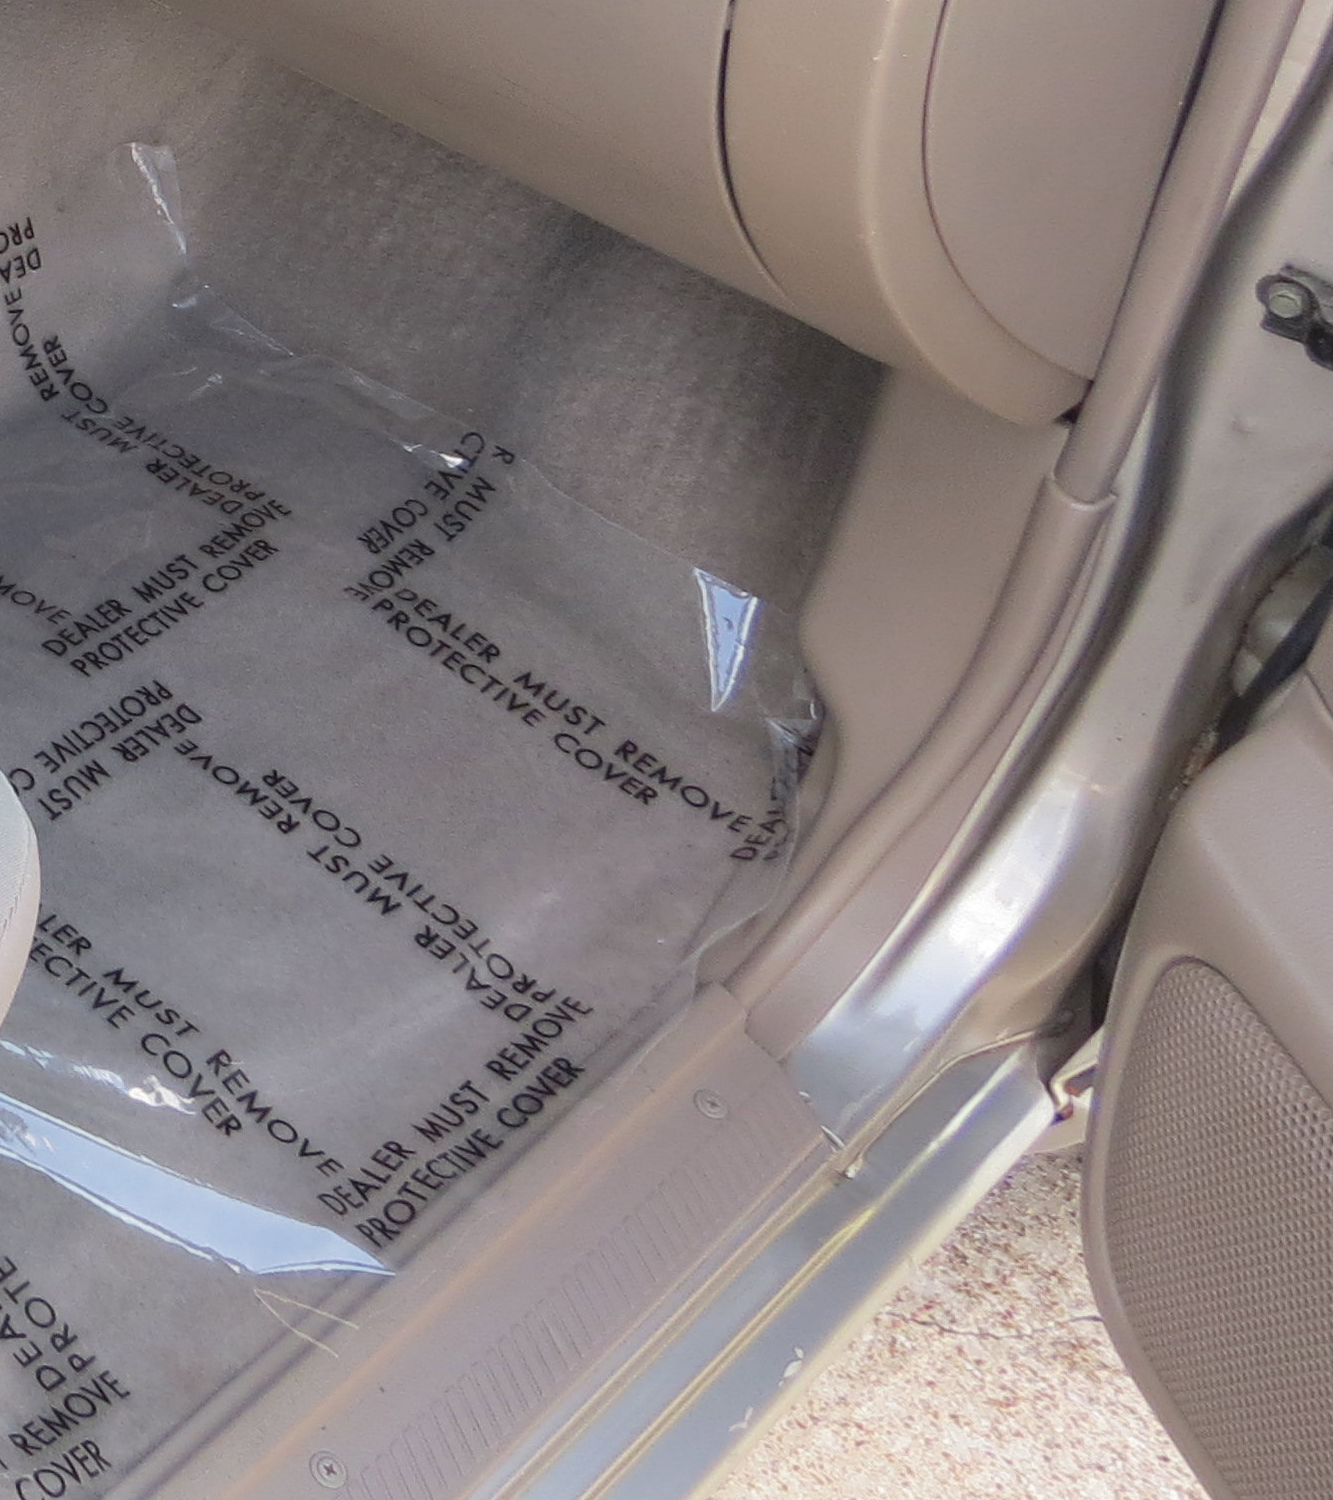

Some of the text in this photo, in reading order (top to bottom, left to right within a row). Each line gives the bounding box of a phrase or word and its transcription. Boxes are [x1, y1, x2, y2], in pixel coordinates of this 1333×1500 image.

[4, 287, 244, 515] DEALER MUST REMOVE
[43, 335, 266, 501] PROTECTIVE COVER
[41, 500, 292, 657] DEALER MUST REMOVE
[70, 539, 280, 677] PROTECTIVE COVER
[343, 476, 496, 601] MUST REMOVE
[357, 499, 428, 554] COVER
[34, 679, 174, 774] PROTECTIVE
[37, 759, 112, 821] MUST
[111, 703, 203, 762] DEALER
[371, 598, 547, 728] PROTECTIVE
[553, 732, 659, 806] COVER
[395, 587, 501, 664] DEALER
[513, 670, 606, 736] MUST
[614, 739, 753, 833] REMOVE
[174, 739, 532, 1023] DEALER MUST REMOVE
[262, 769, 556, 1003] PROTECTIVE COVER
[29, 940, 244, 1137] ECTIVE COVER
[37, 914, 345, 1177] LER MUST REMOVE
[317, 996, 595, 1217] DEALER MUST REMOVE
[354, 1057, 586, 1249] PROTECTIVE COVER
[8, 1369, 131, 1457] REMOVE
